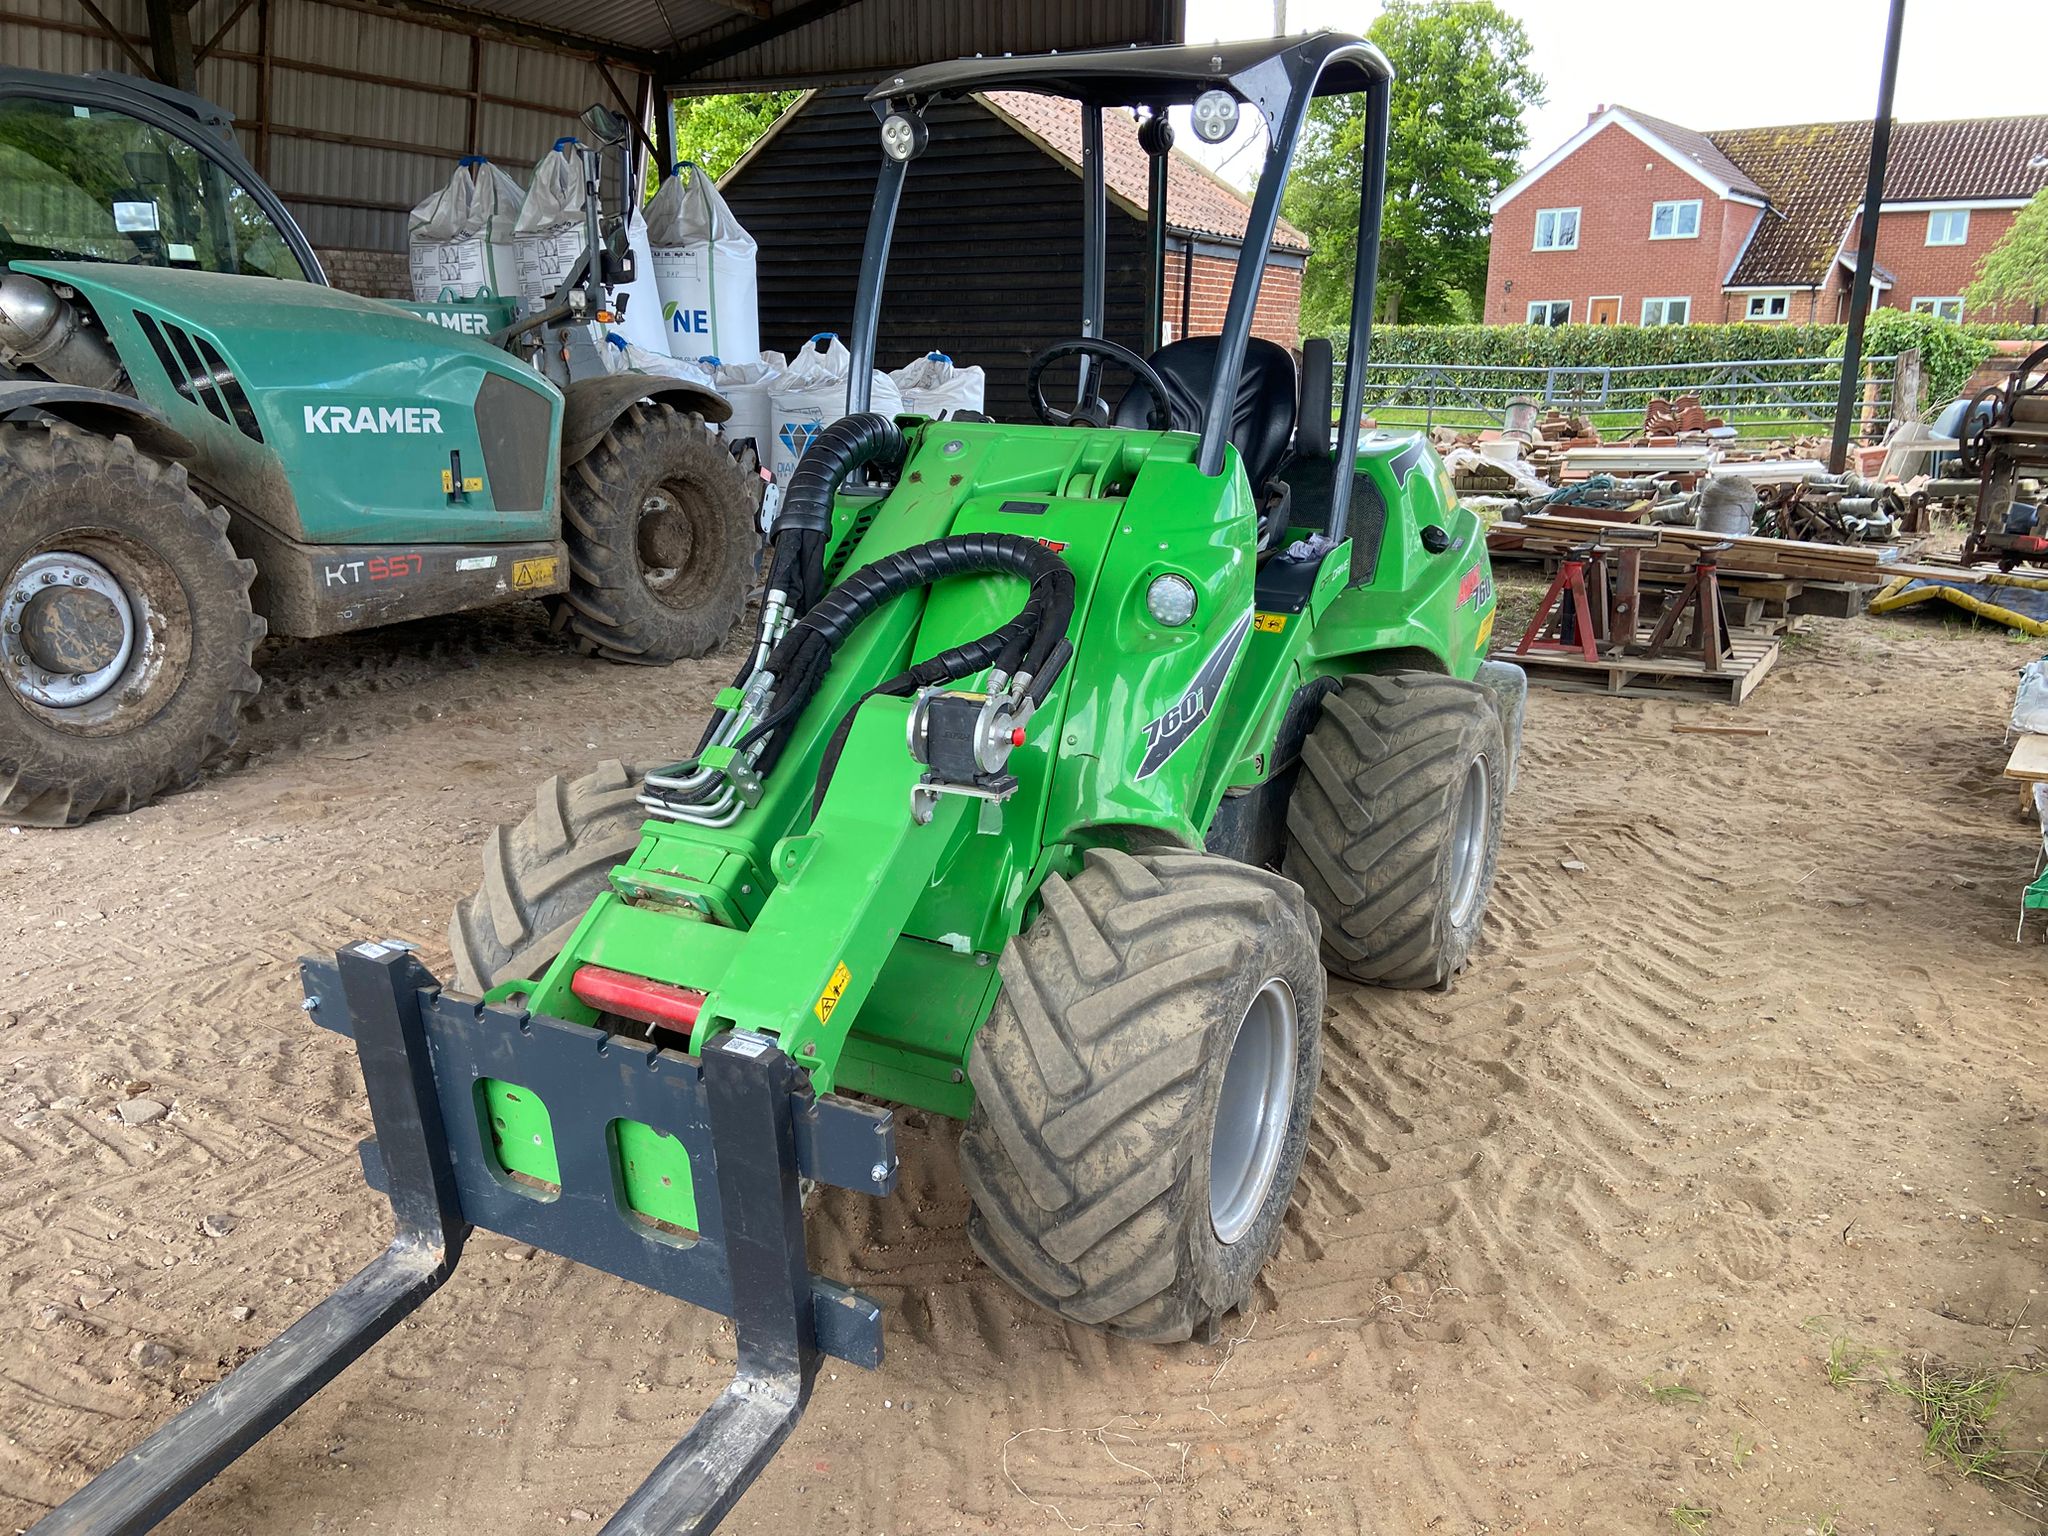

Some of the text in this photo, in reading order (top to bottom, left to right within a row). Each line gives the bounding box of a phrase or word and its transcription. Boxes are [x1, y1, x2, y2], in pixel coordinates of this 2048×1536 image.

[410, 311, 491, 335] AMER
[673, 309, 708, 333] NE
[303, 405, 444, 434] KRAMER
[325, 554, 423, 587] KT 557
[1141, 686, 1204, 751] 760i
